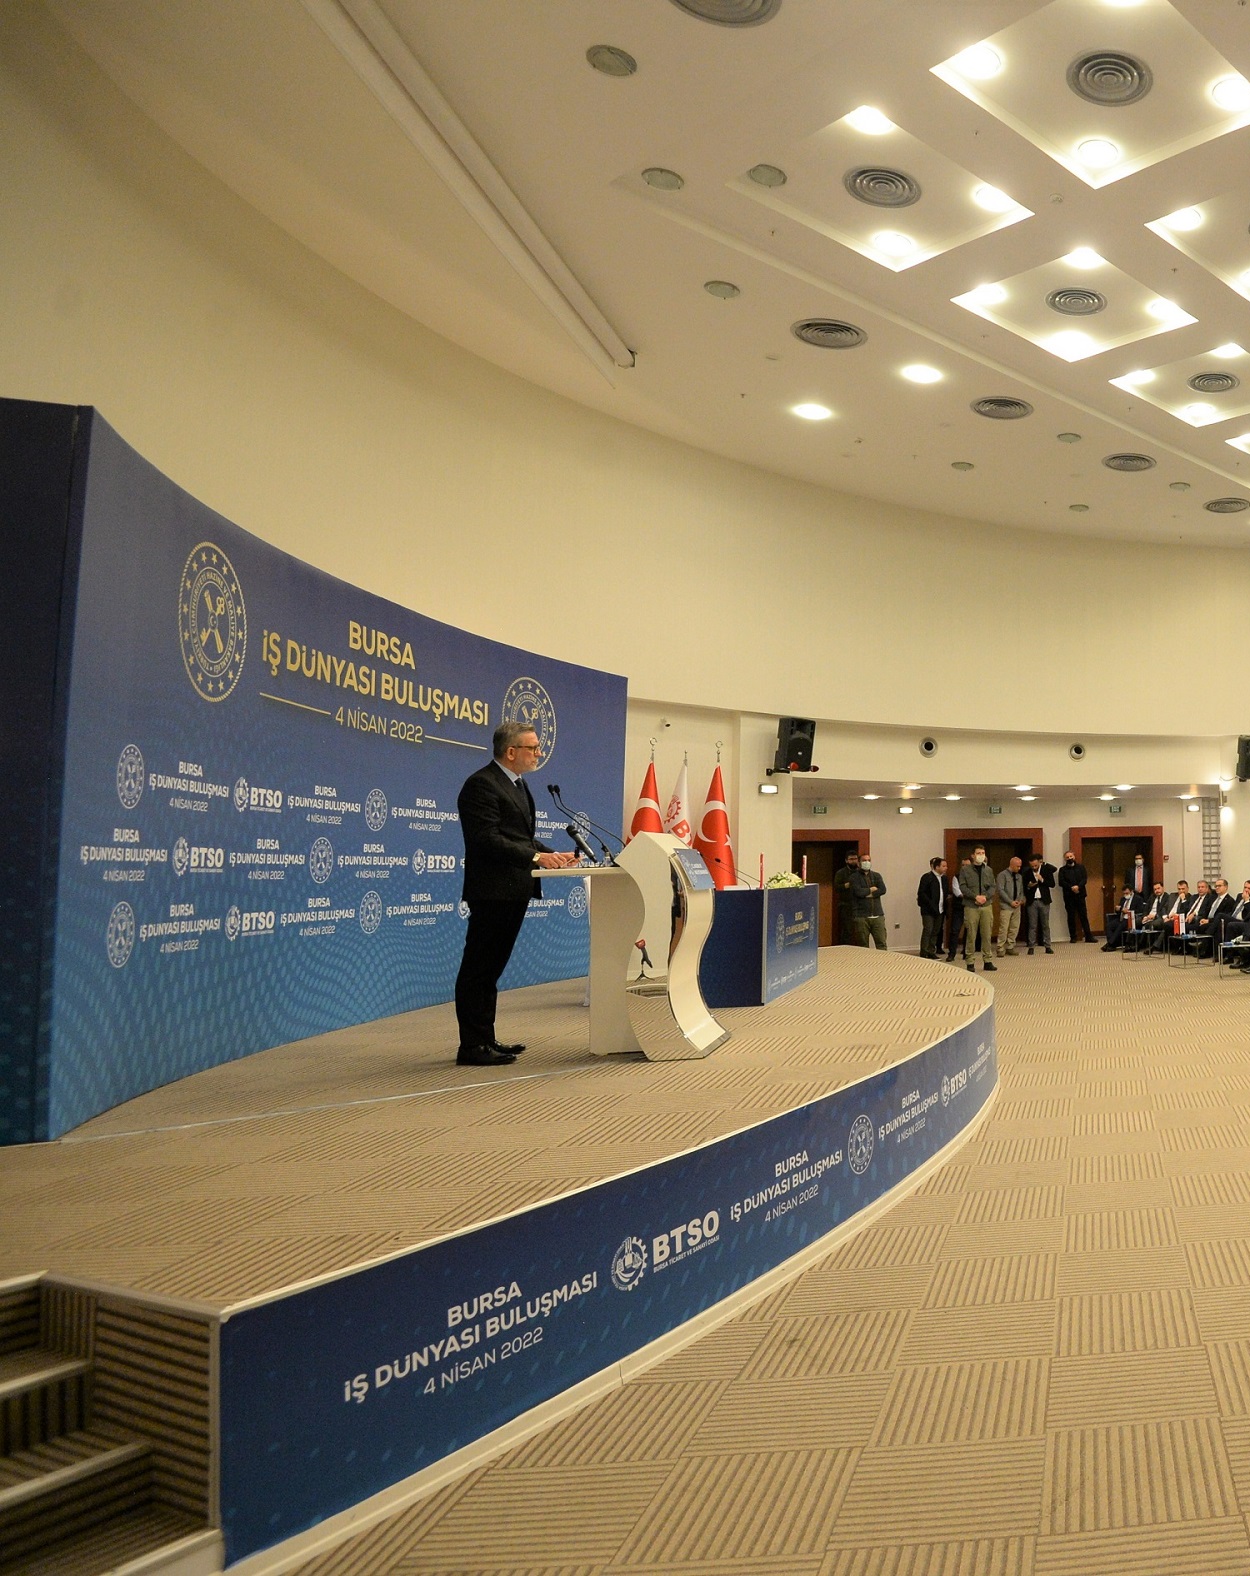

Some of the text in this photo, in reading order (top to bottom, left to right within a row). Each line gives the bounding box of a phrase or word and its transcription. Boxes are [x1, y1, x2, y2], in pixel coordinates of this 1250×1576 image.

[349, 620, 416, 670] BURSA
[262, 629, 282, 677] İŞ
[286, 639, 376, 696] DÜNYASI
[381, 672, 489, 726] BULUŞMASI
[335, 706, 423, 743] 4 NİSAN 2022
[179, 761, 203, 777] BURSA
[189, 781, 229, 798] BULUŞMASI
[315, 785, 337, 797] BURSA
[174, 798, 192, 811] NİSAN
[192, 801, 208, 812] 2022
[250, 787, 282, 808] BTSO
[416, 798, 436, 808] BURSA
[324, 799, 361, 814] BULUŞMASI
[311, 813, 327, 823] NİSAN
[327, 816, 342, 825] 2022
[535, 811, 548, 819] RSA
[113, 828, 140, 843] BURSA
[428, 824, 442, 832] 2022
[256, 838, 280, 850] BURSA
[363, 844, 385, 853] BURSA
[125, 849, 168, 866] BULUŞMASI
[190, 847, 224, 868] BTSO
[266, 853, 305, 868] BULUŞMASI
[427, 855, 456, 870] BTSO
[107, 869, 128, 881] NİSAN
[128, 870, 145, 881] 2022
[252, 869, 270, 880] NİSAN
[270, 871, 285, 880] 2022
[376, 871, 389, 879] 2022
[308, 897, 330, 908] BURSA
[411, 893, 431, 902] BURSA
[170, 903, 194, 917] BURSA
[318, 909, 355, 922] BULUŞMASI
[180, 918, 220, 935] BULUŞMASI
[242, 911, 275, 932] BTSO
[423, 917, 436, 925] 2022
[303, 926, 321, 936] NİSAN
[321, 926, 336, 935] 2022
[165, 941, 183, 953] NİSAN
[183, 939, 199, 950] 2022
[901, 1089, 921, 1109] BURSA
[910, 1091, 939, 1119] BULUŞMASI
[775, 1150, 809, 1178] BURSA
[730, 1149, 843, 1223] İŞ DÜNYASI BULUŞMASI
[764, 1184, 819, 1223] 4 NİSAN 2022
[652, 1210, 720, 1266] BTSO
[446, 1281, 523, 1328] BURSA
[344, 1271, 598, 1404] İŞ DÜNYASI BULUŞMASI
[423, 1326, 544, 1395] 4 NİSAN 2022
